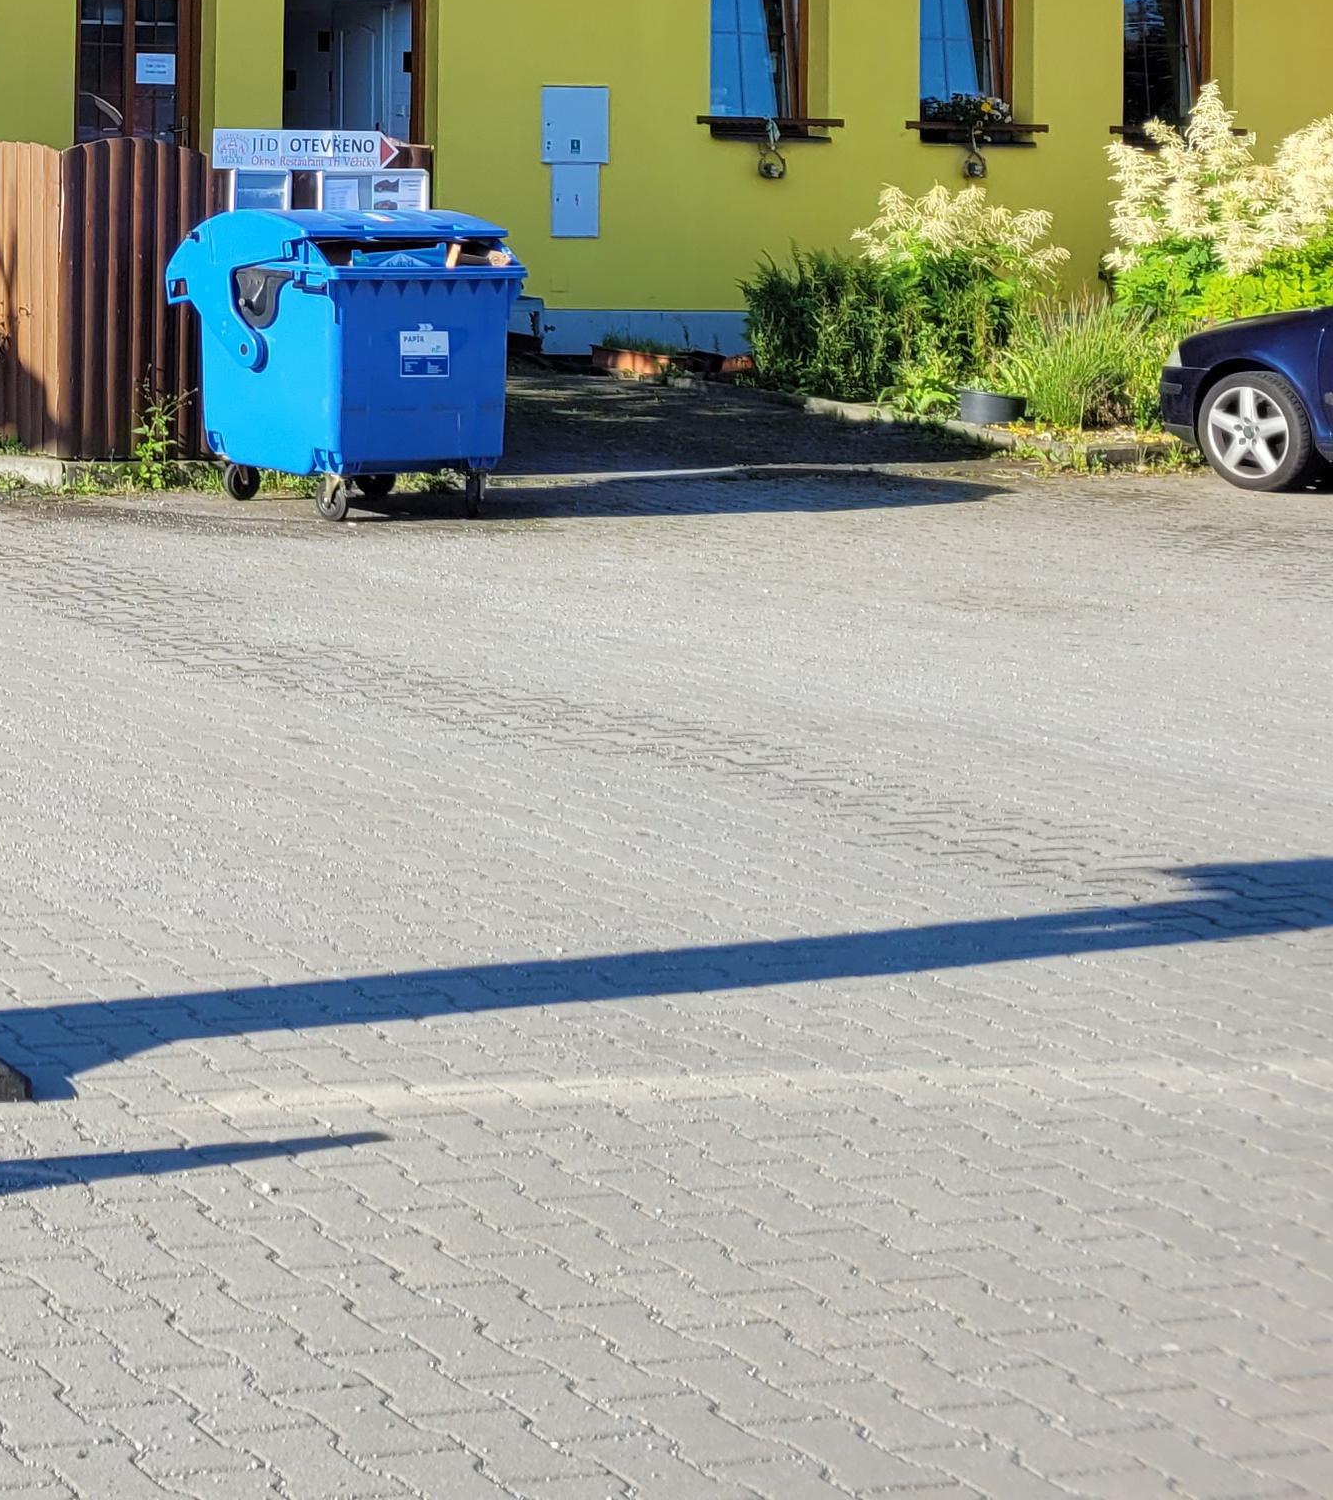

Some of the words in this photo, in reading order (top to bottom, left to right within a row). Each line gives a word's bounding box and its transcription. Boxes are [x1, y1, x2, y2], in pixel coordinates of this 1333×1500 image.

[290, 135, 375, 153] OTEVŘENO
[251, 155, 276, 166] Okno
[279, 156, 324, 167] Restaurant
